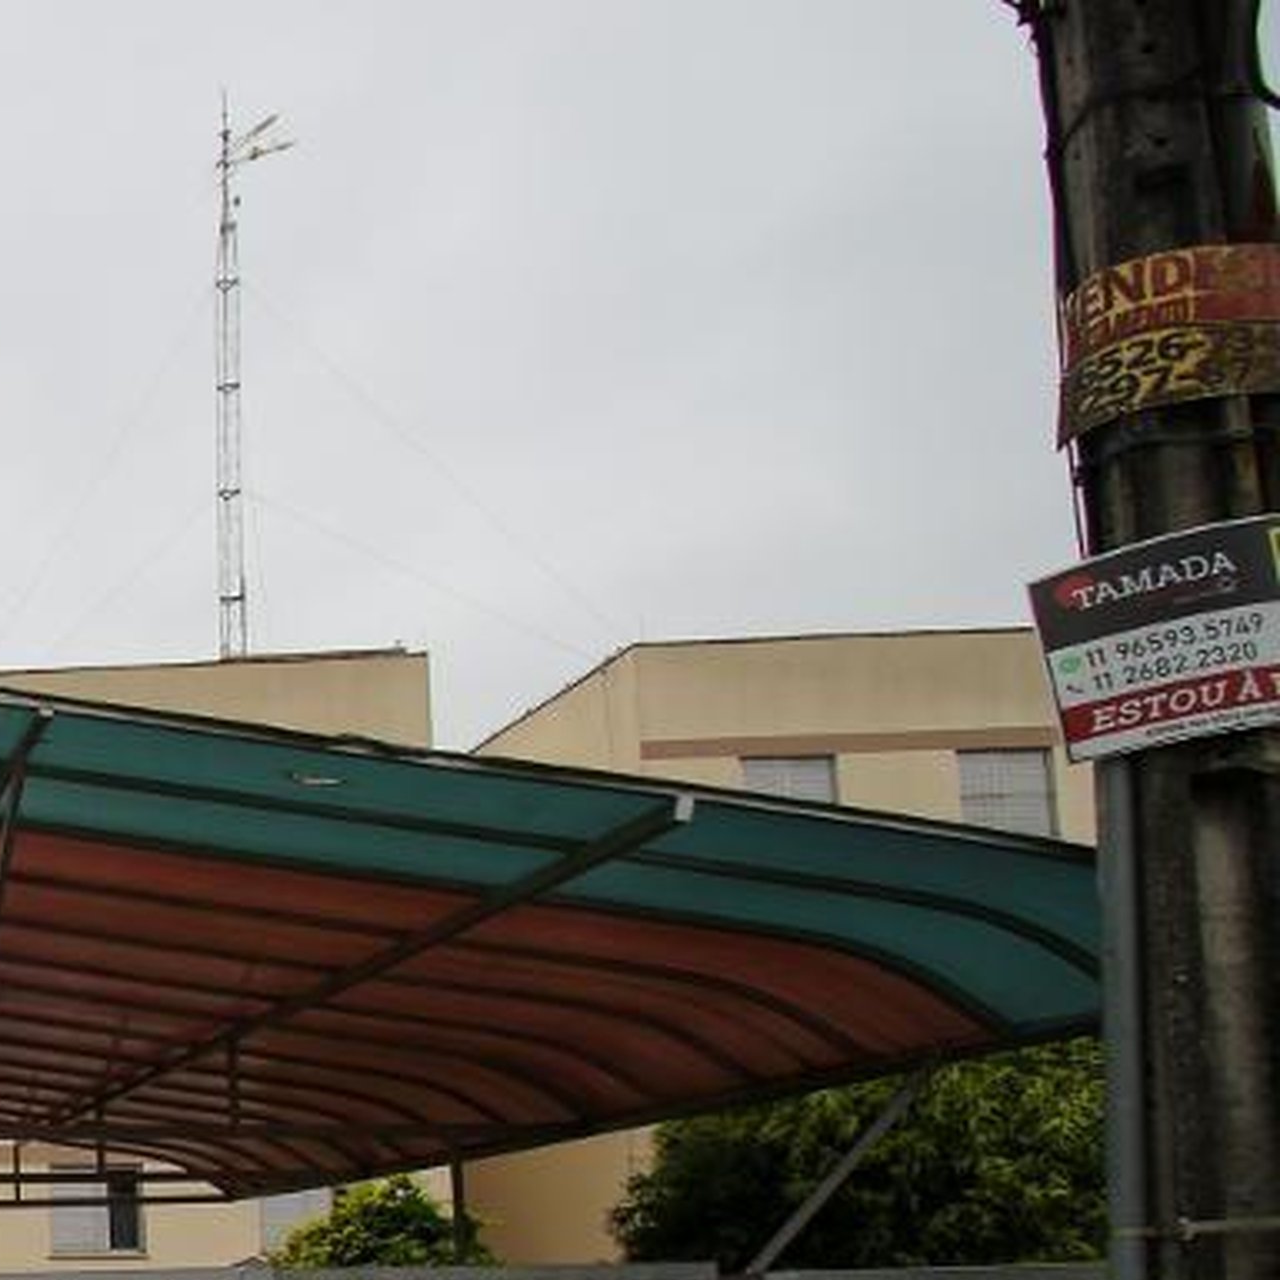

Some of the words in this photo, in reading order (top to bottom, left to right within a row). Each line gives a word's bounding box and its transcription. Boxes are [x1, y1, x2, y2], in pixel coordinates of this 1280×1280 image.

[1071, 550, 1237, 609] TAMADA
[1086, 647, 1107, 668] 11
[1094, 673, 1114, 690] 11
[1124, 641, 1257, 684] 2682.2320
[1092, 681, 1227, 731] ESTOU
